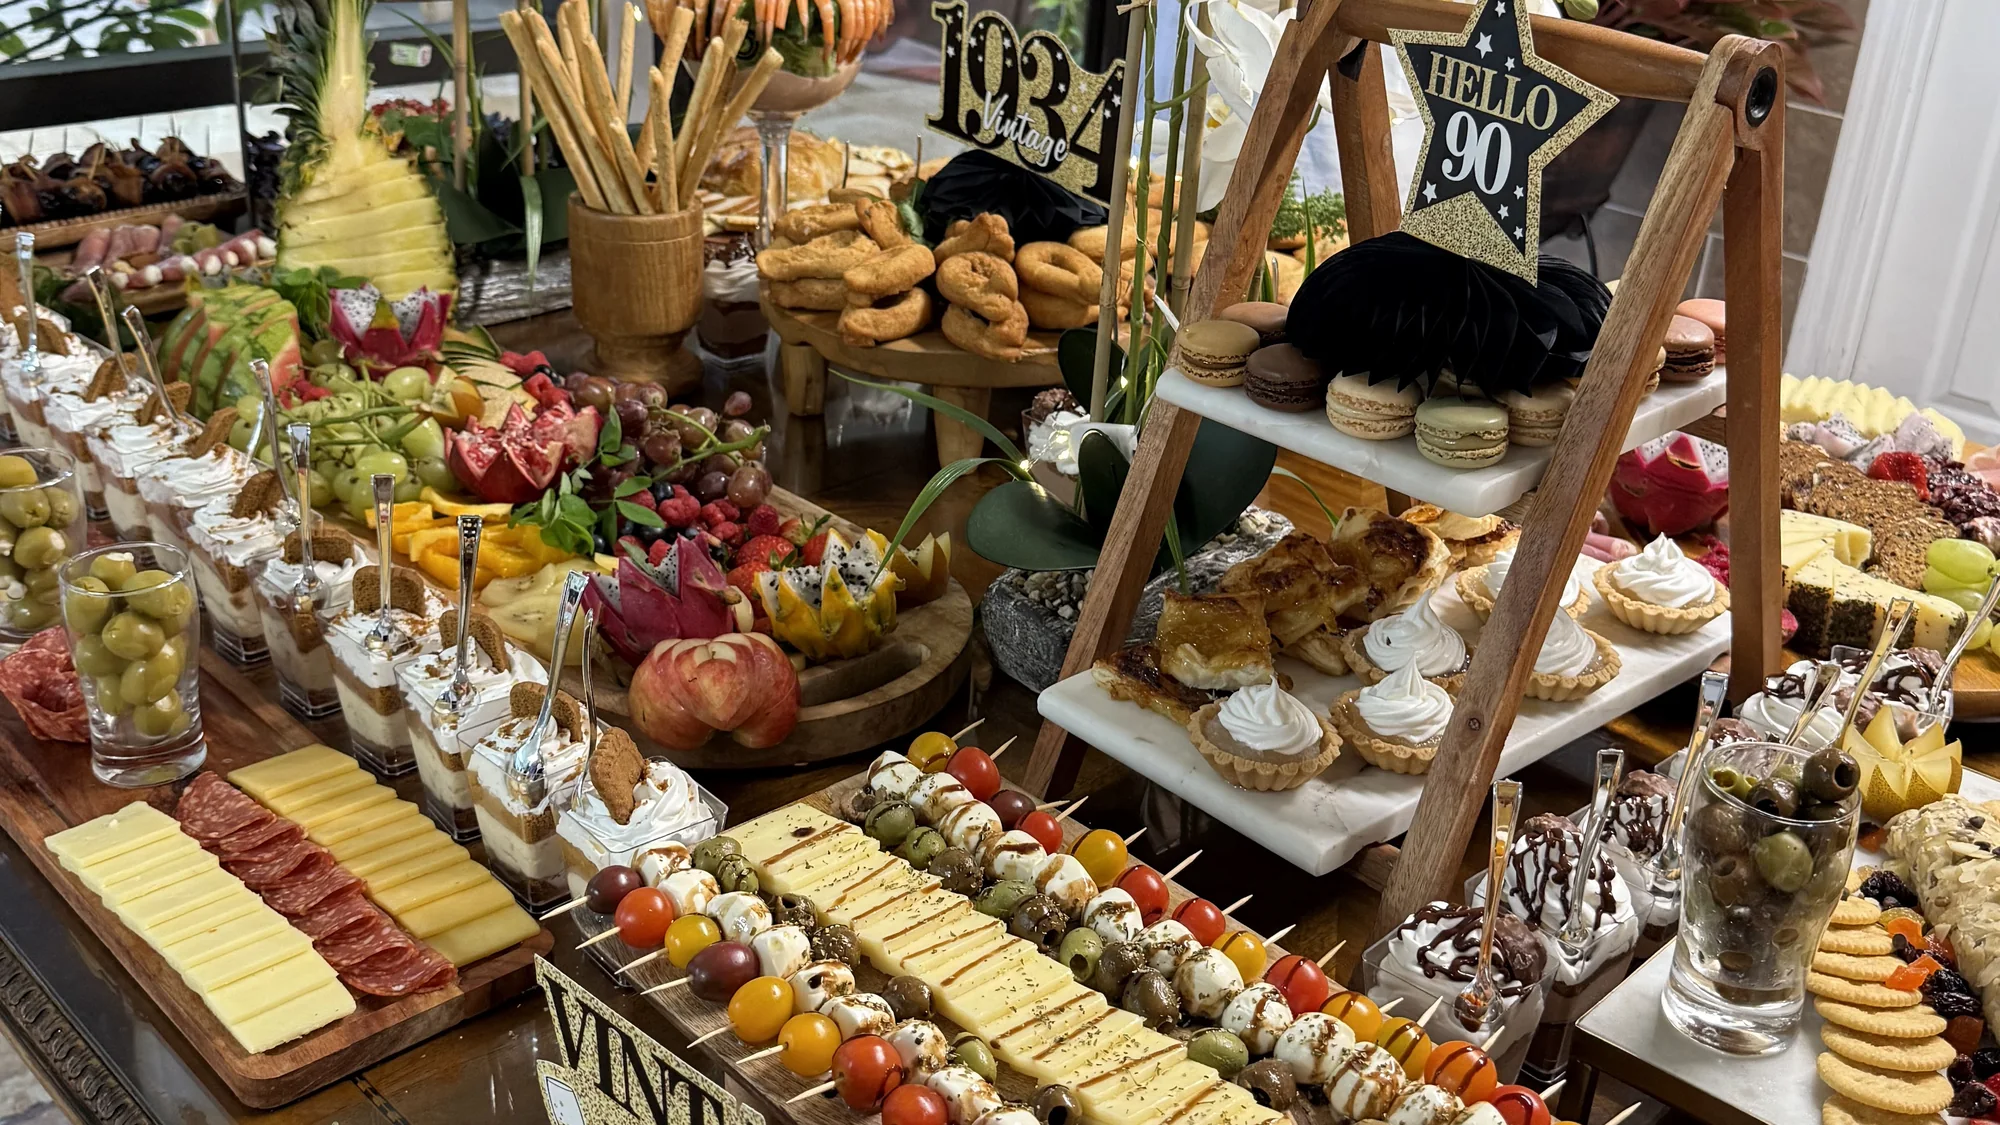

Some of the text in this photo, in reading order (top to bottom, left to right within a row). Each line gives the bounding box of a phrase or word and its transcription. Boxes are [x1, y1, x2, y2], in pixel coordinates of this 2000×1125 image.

[928, 4, 1124, 203] 1934
[982, 90, 1068, 167] Vintage
[1424, 51, 1558, 131] HELLO
[1441, 110, 1512, 195] 90
[543, 975, 754, 1125] VINT
